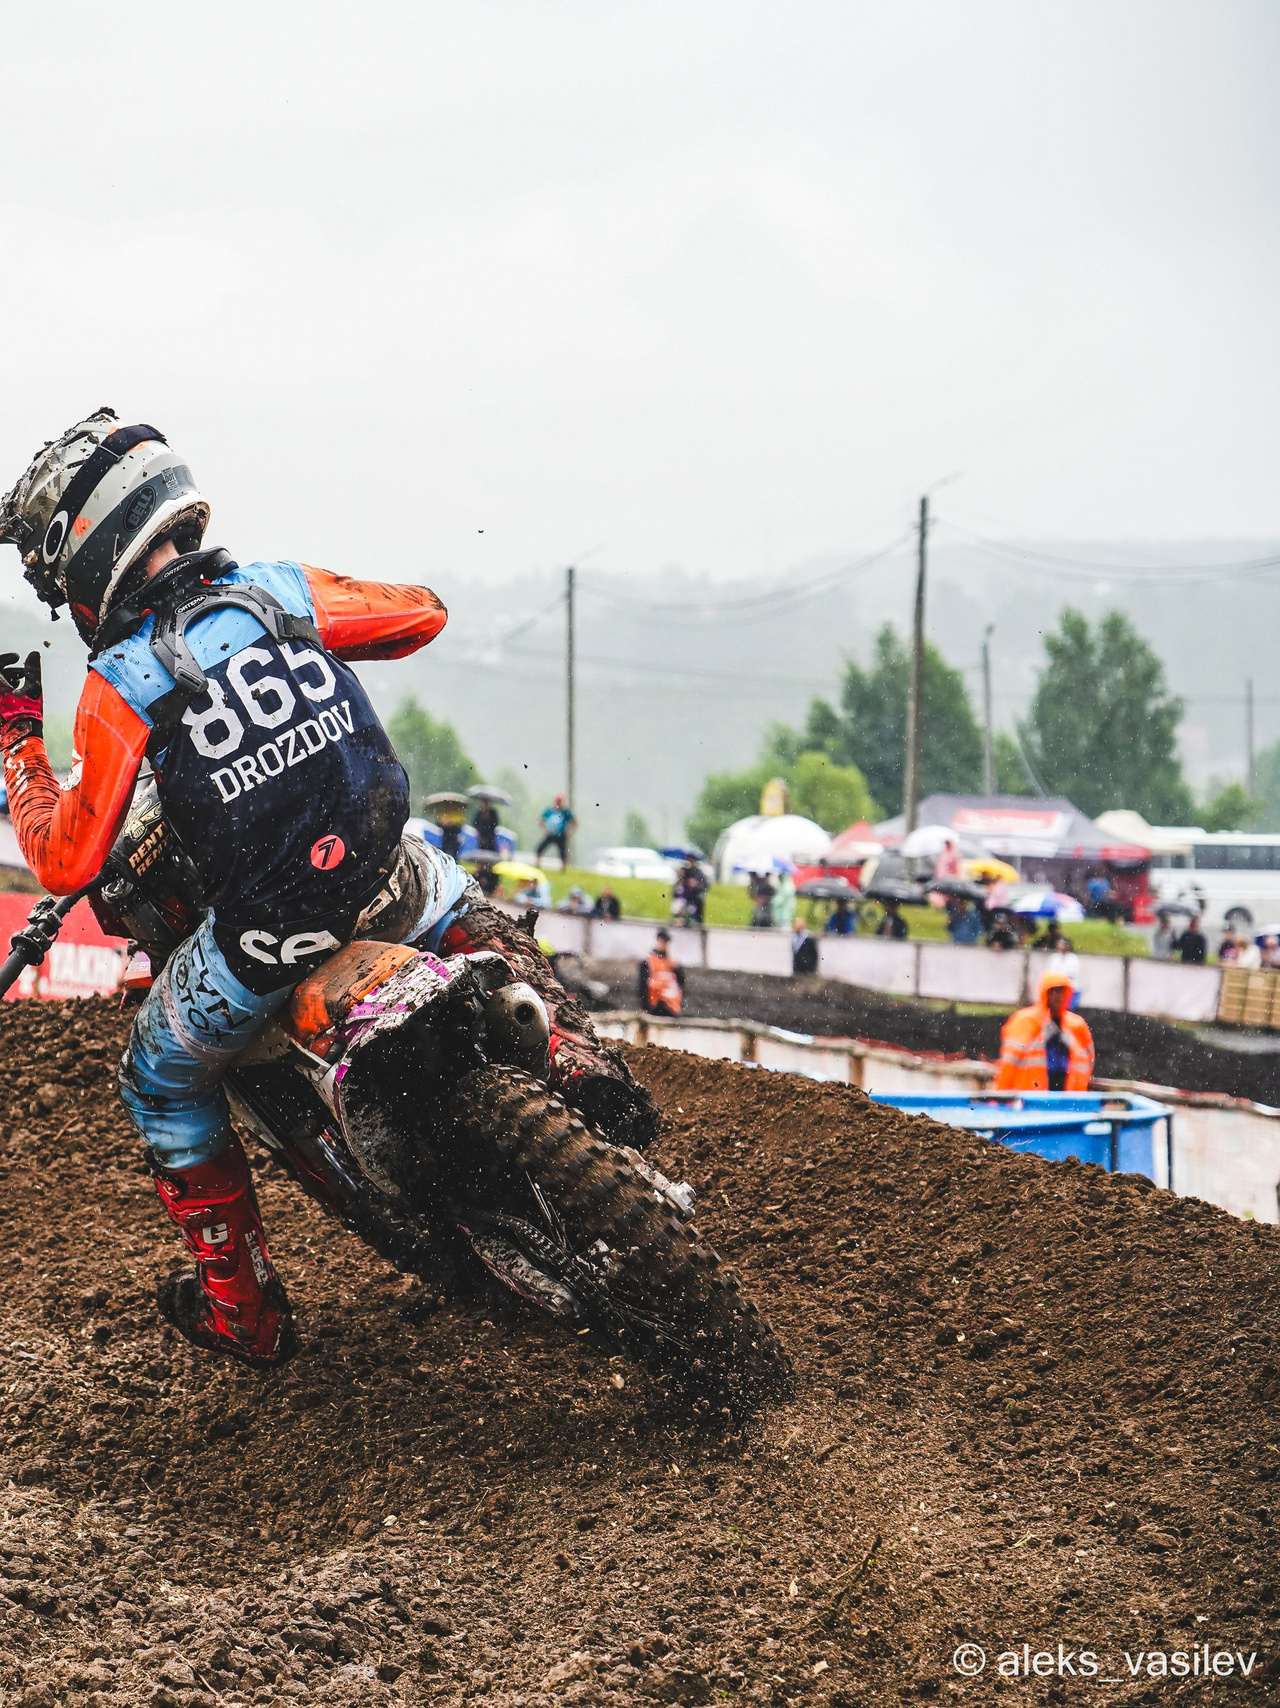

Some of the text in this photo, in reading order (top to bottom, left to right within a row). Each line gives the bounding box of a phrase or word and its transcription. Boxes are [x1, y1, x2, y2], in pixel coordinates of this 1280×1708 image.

[127, 492, 153, 526] BELL
[163, 560, 190, 578] ORTEMA
[177, 596, 206, 613] ORTEMA
[181, 642, 336, 759] 865
[210, 700, 355, 804] DROZDOV
[202, 1222, 229, 1245] G
